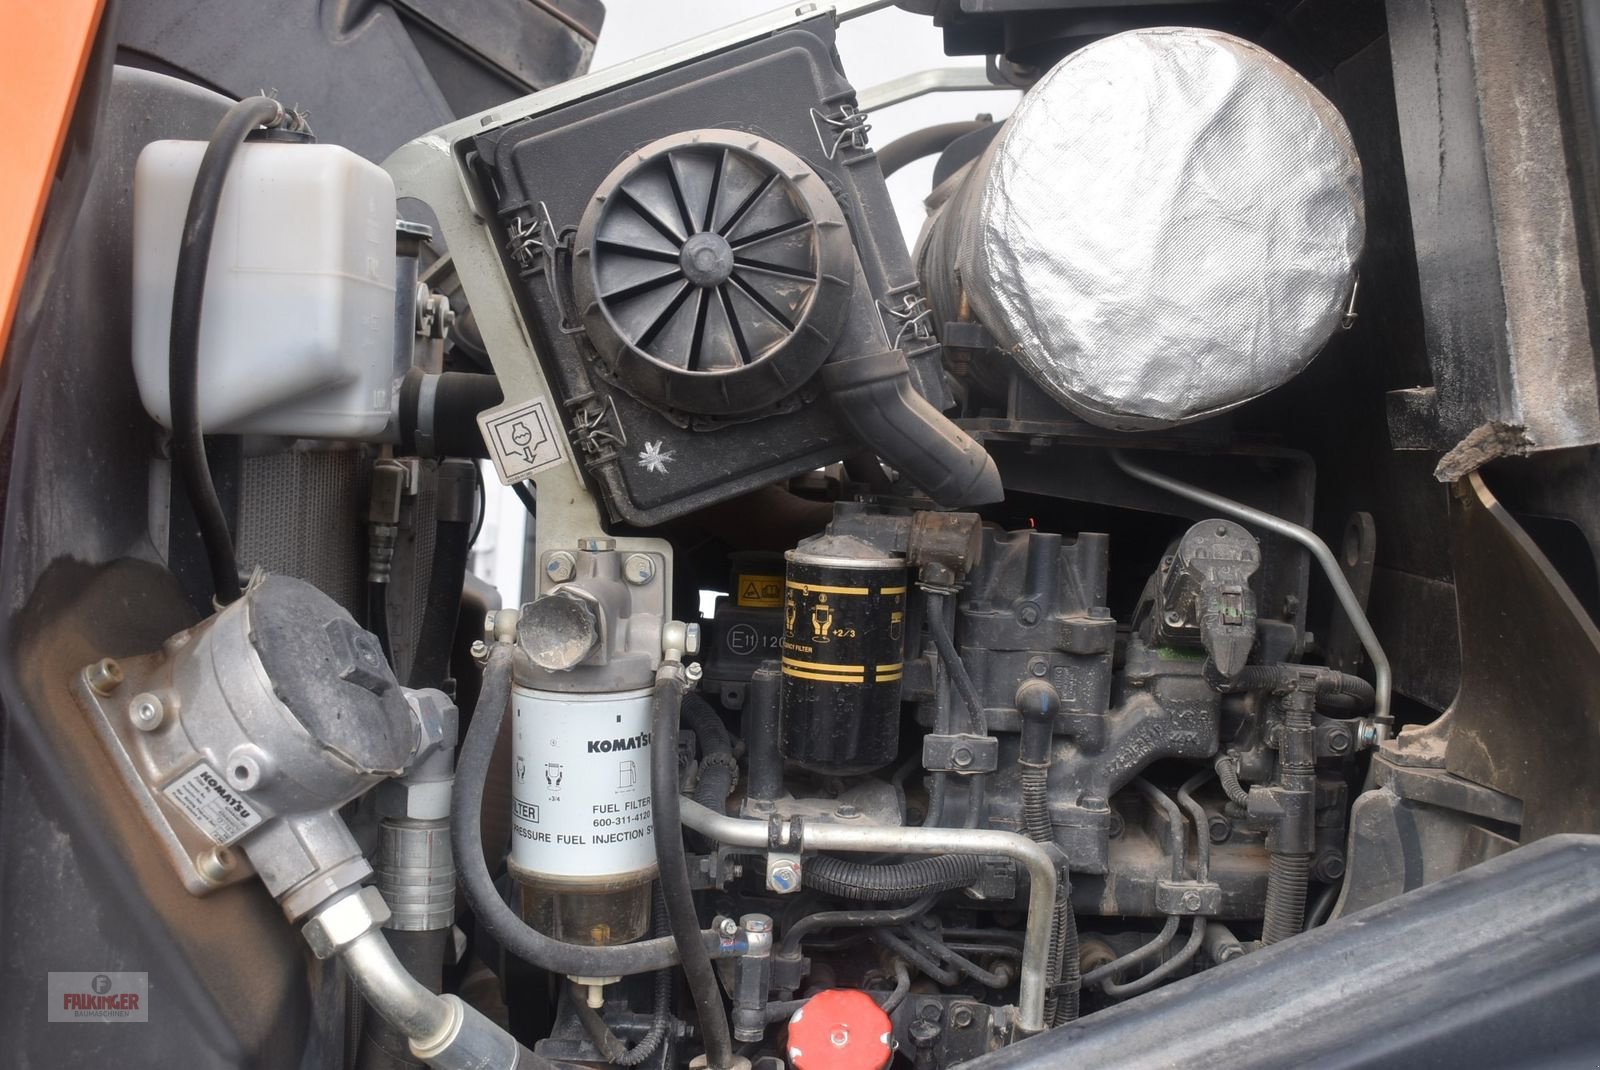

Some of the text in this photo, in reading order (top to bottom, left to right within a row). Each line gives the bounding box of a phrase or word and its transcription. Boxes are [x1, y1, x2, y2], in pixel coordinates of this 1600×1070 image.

[832, 629, 856, 638] +2/3
[199, 770, 252, 819] KOMATSU
[513, 800, 536, 819] LTER
[592, 796, 651, 814] FUEL FILTER
[592, 810, 651, 827] 600-311-4120
[556, 834, 586, 845] FUEL
[592, 828, 644, 844] INJECTION
